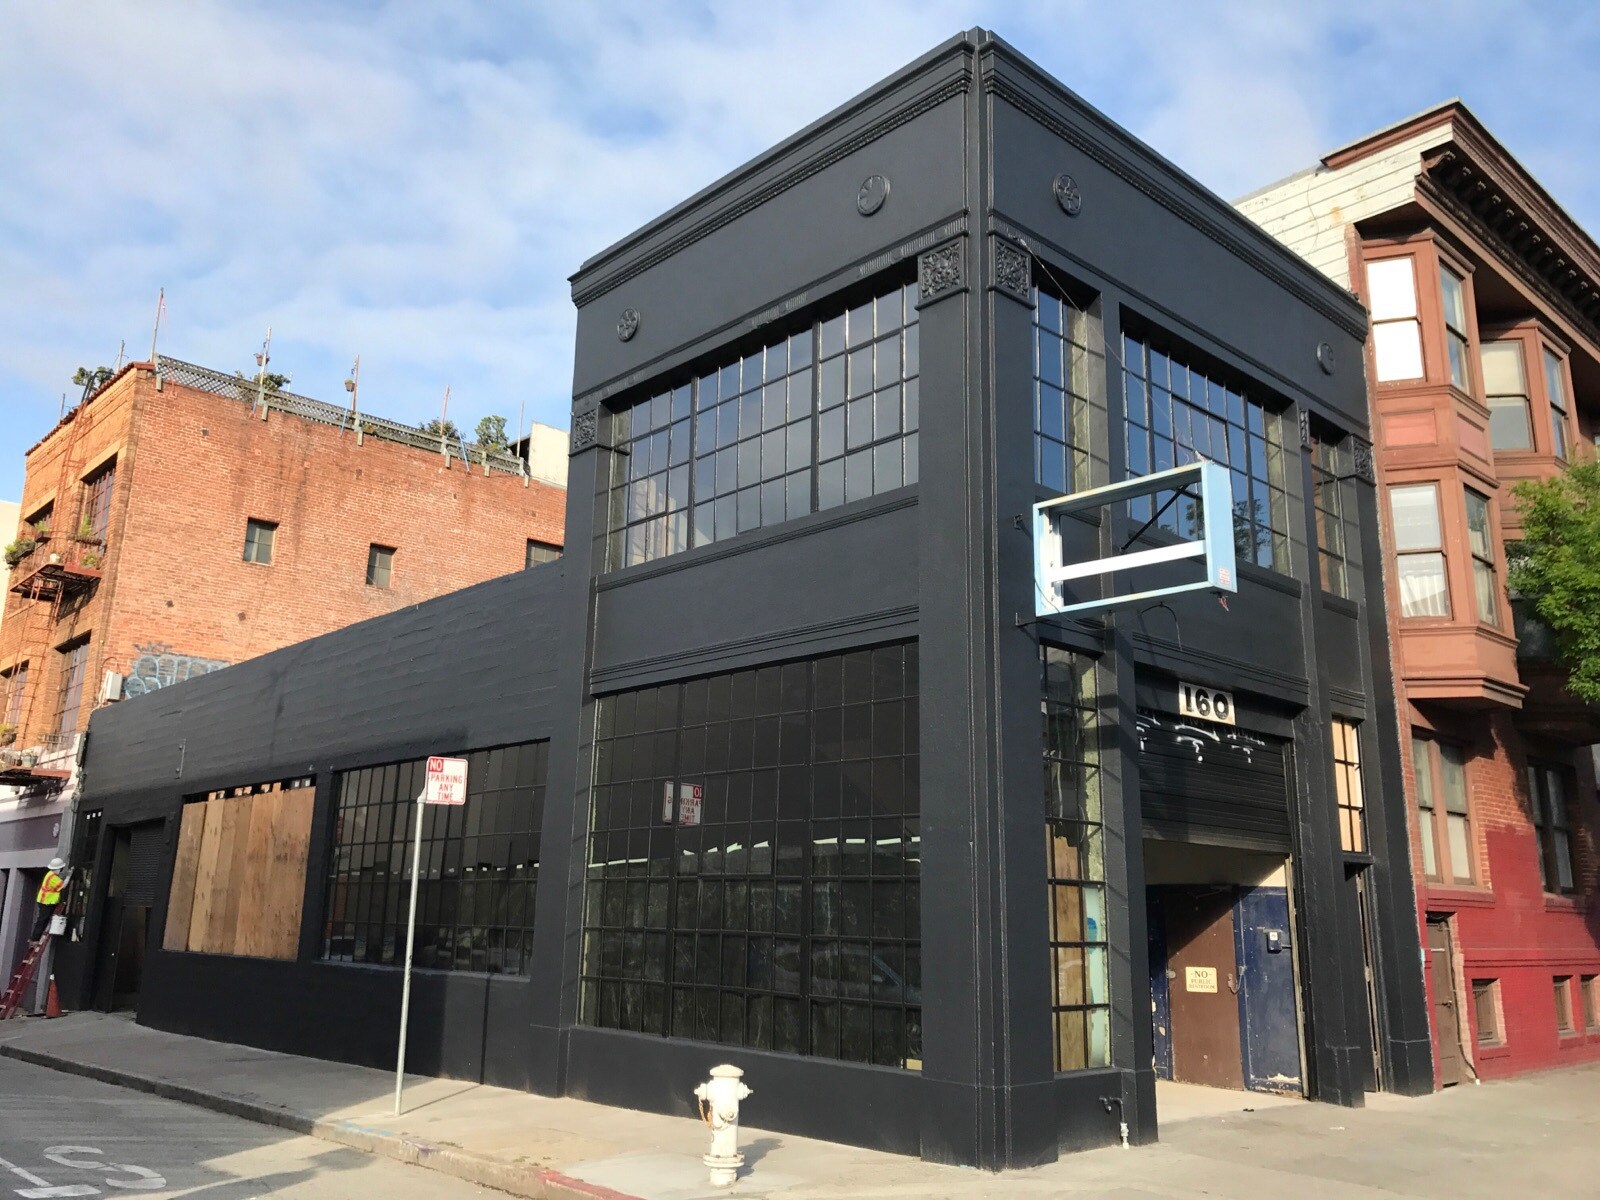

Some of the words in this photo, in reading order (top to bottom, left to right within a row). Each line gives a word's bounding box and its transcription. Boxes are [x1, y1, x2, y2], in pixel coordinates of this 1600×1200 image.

[1184, 686, 1230, 720] 160
[429, 758, 443, 772] NO
[430, 774, 463, 784] PARKING
[439, 783, 454, 792] ANY
[437, 792, 454, 801] TIME
[1194, 970, 1208, 978] NO
